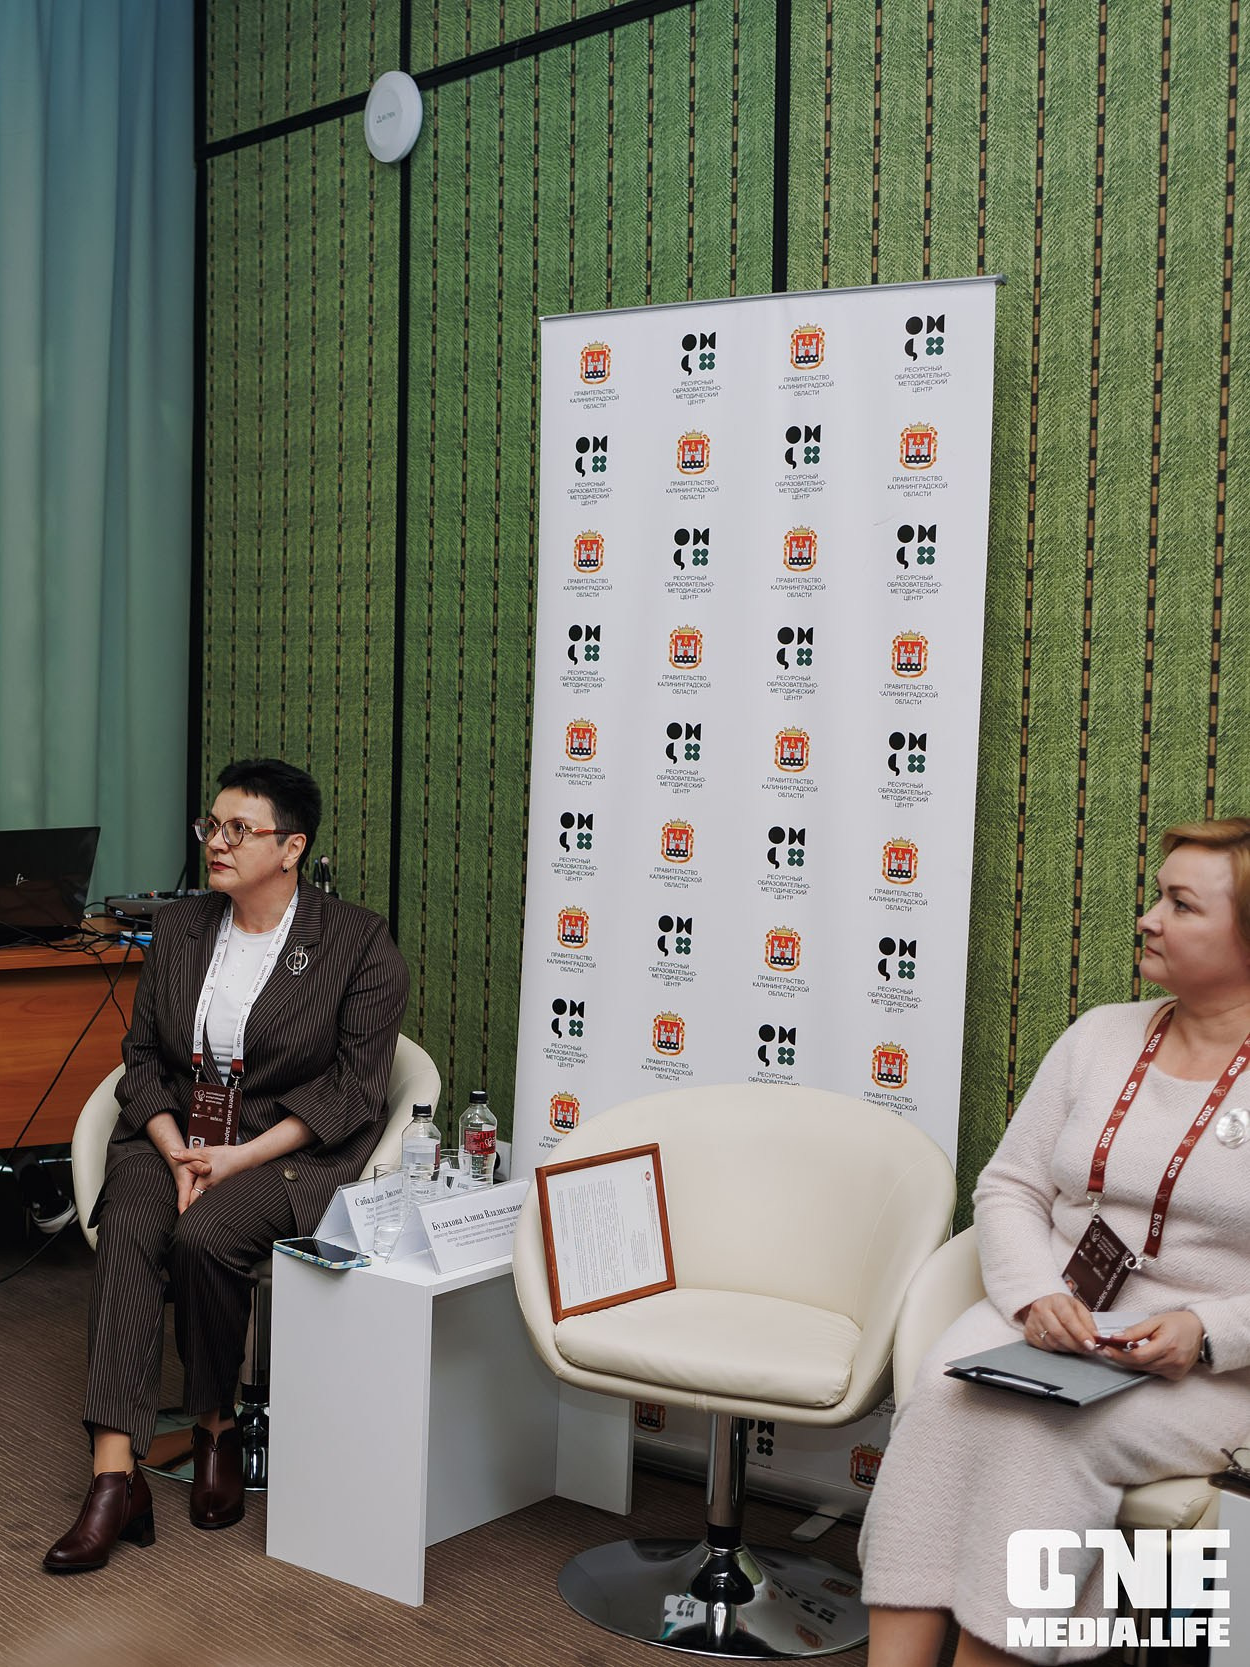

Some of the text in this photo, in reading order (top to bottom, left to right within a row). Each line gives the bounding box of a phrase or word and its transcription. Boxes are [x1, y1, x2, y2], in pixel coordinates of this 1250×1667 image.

[1145, 1032, 1161, 1053] 2026
[1228, 1055, 1246, 1077] БКФ
[1121, 1081, 1137, 1101] БКФ
[1195, 1104, 1215, 1127] 2026
[1099, 1126, 1115, 1149] 2026
[1167, 1156, 1184, 1179] БКФ
[431, 1219, 463, 1232] Булахова
[1151, 1213, 1163, 1237] БКФ
